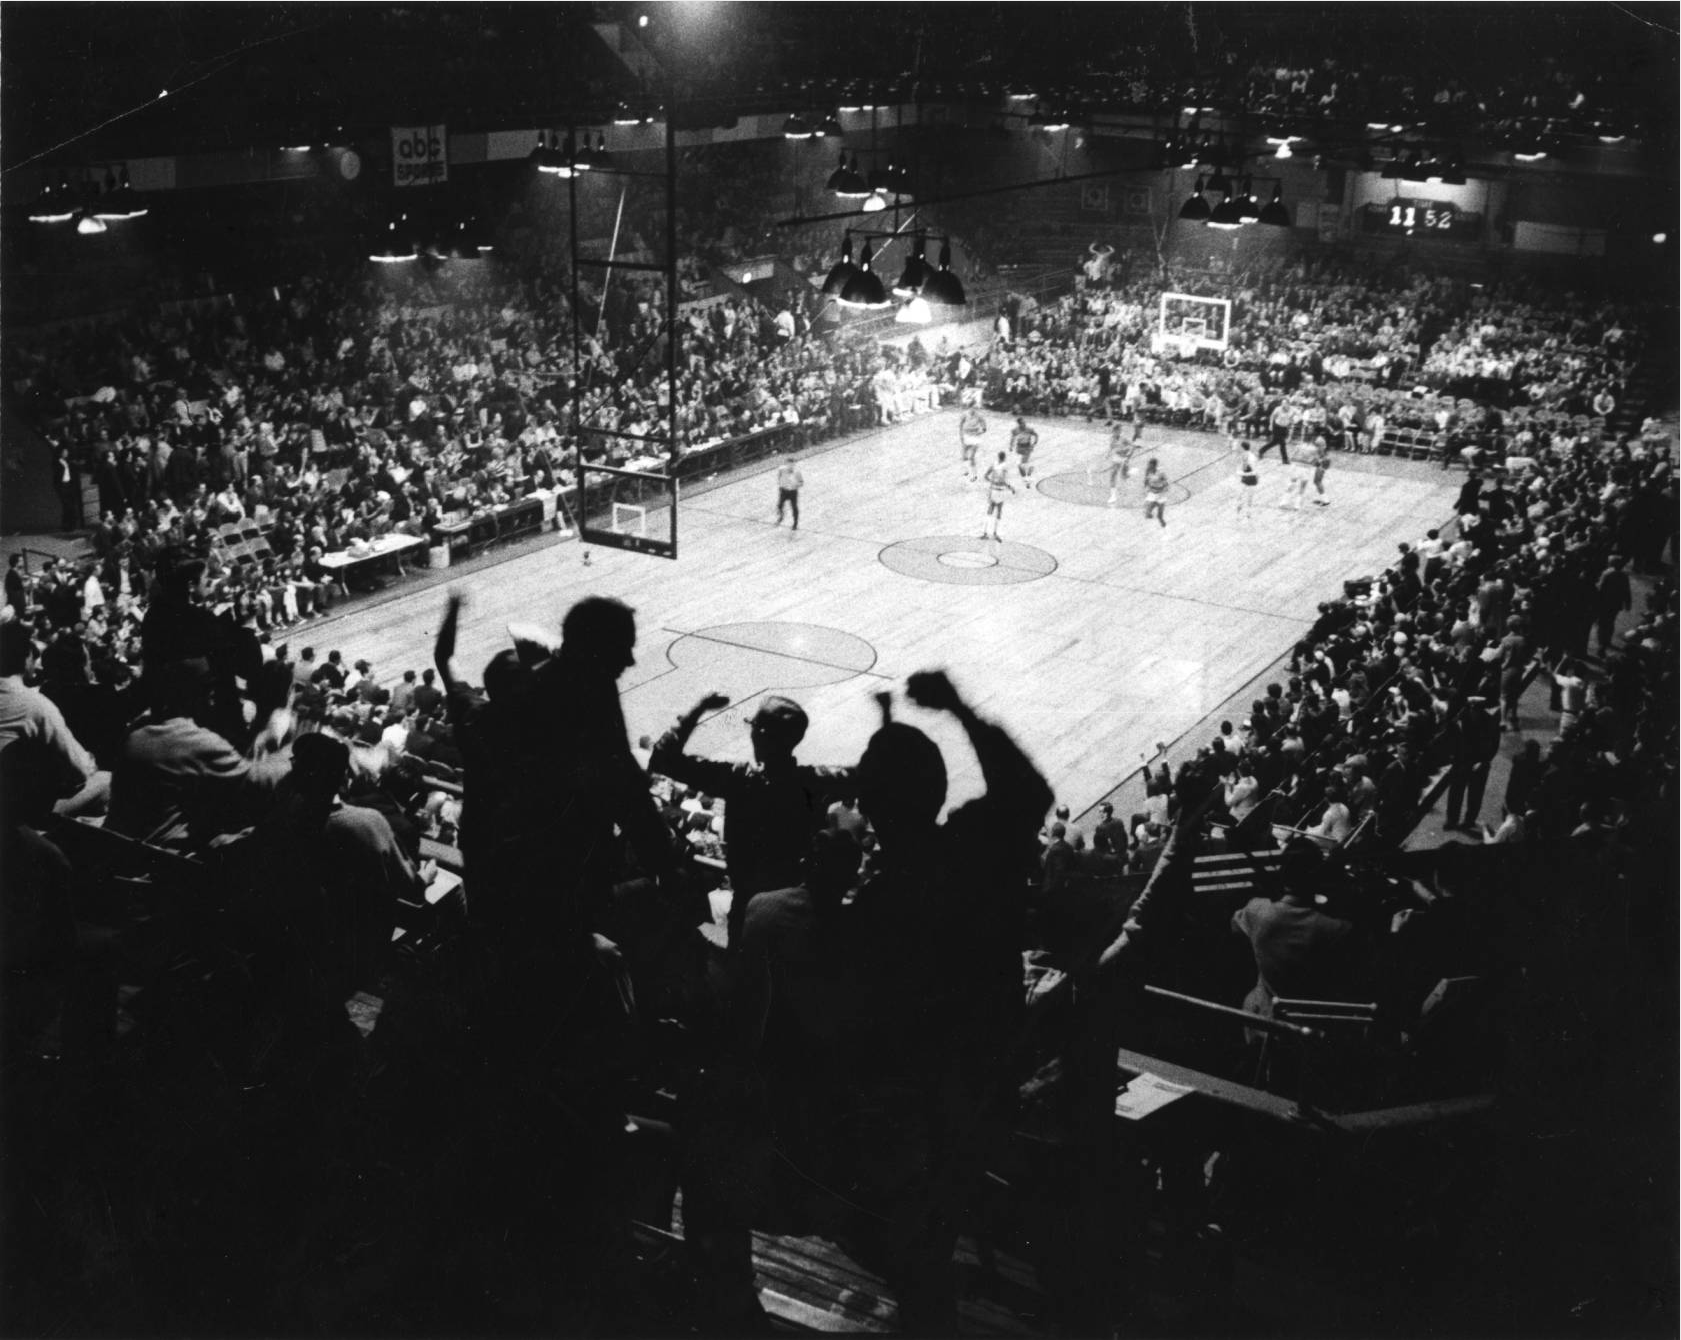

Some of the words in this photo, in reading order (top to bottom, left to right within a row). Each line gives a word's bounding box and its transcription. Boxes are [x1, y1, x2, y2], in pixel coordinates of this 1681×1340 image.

[399, 131, 441, 158] abc
[1389, 206, 1416, 227] 11
[1424, 209, 1452, 229] 52
